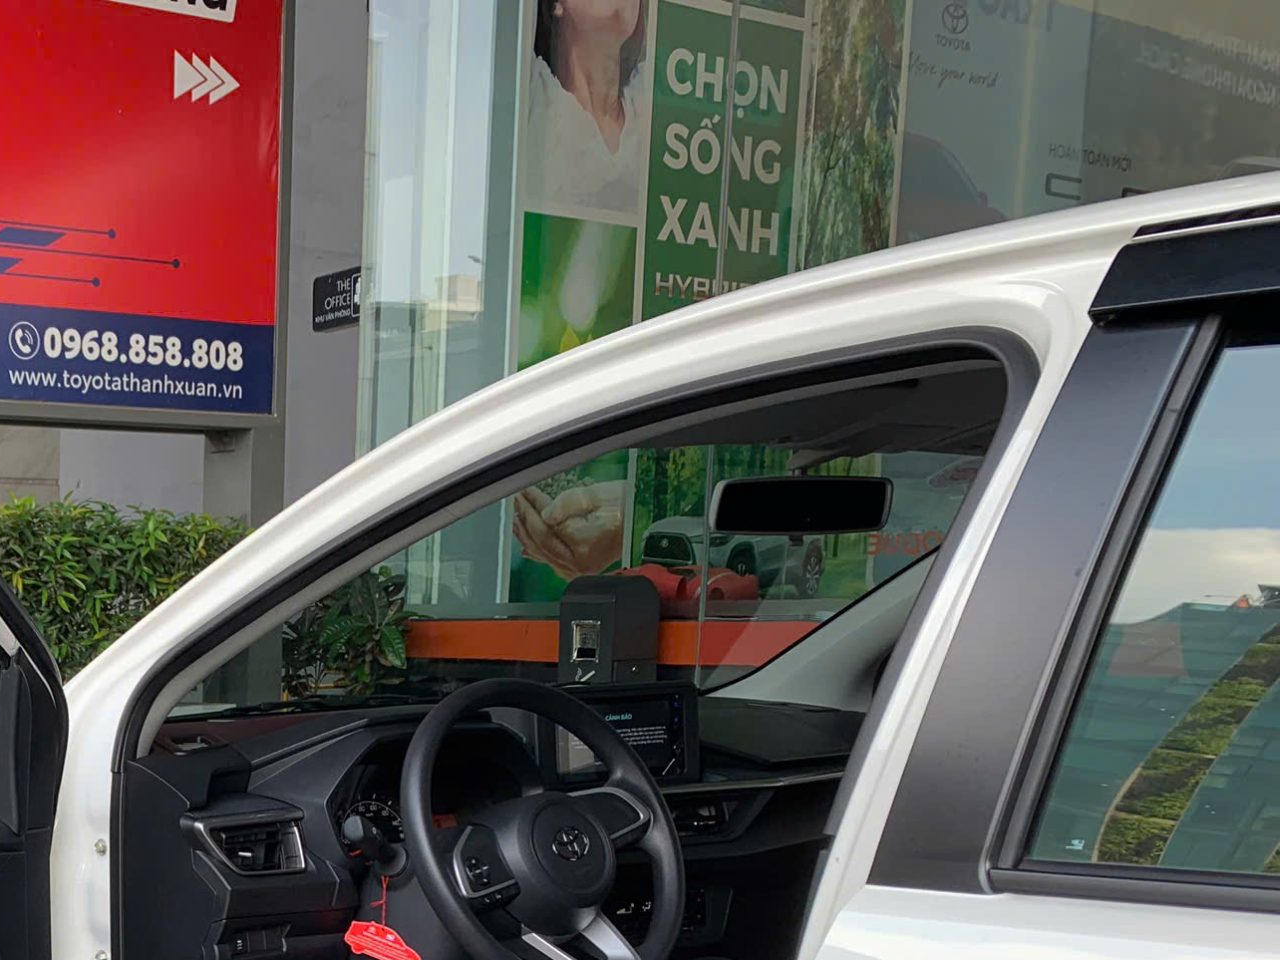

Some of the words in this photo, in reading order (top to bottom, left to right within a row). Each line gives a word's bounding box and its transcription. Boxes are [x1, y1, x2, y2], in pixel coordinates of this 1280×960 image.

[666, 47, 788, 118] CHỌN
[663, 114, 782, 184] SỐNG
[657, 194, 780, 256] XANH
[324, 292, 351, 310] OFFICE
[336, 278, 351, 292] THE
[655, 271, 754, 301] HYB
[43, 326, 244, 372] 0968.858.808
[8, 369, 243, 399] www.toyotathanhxuan.vn
